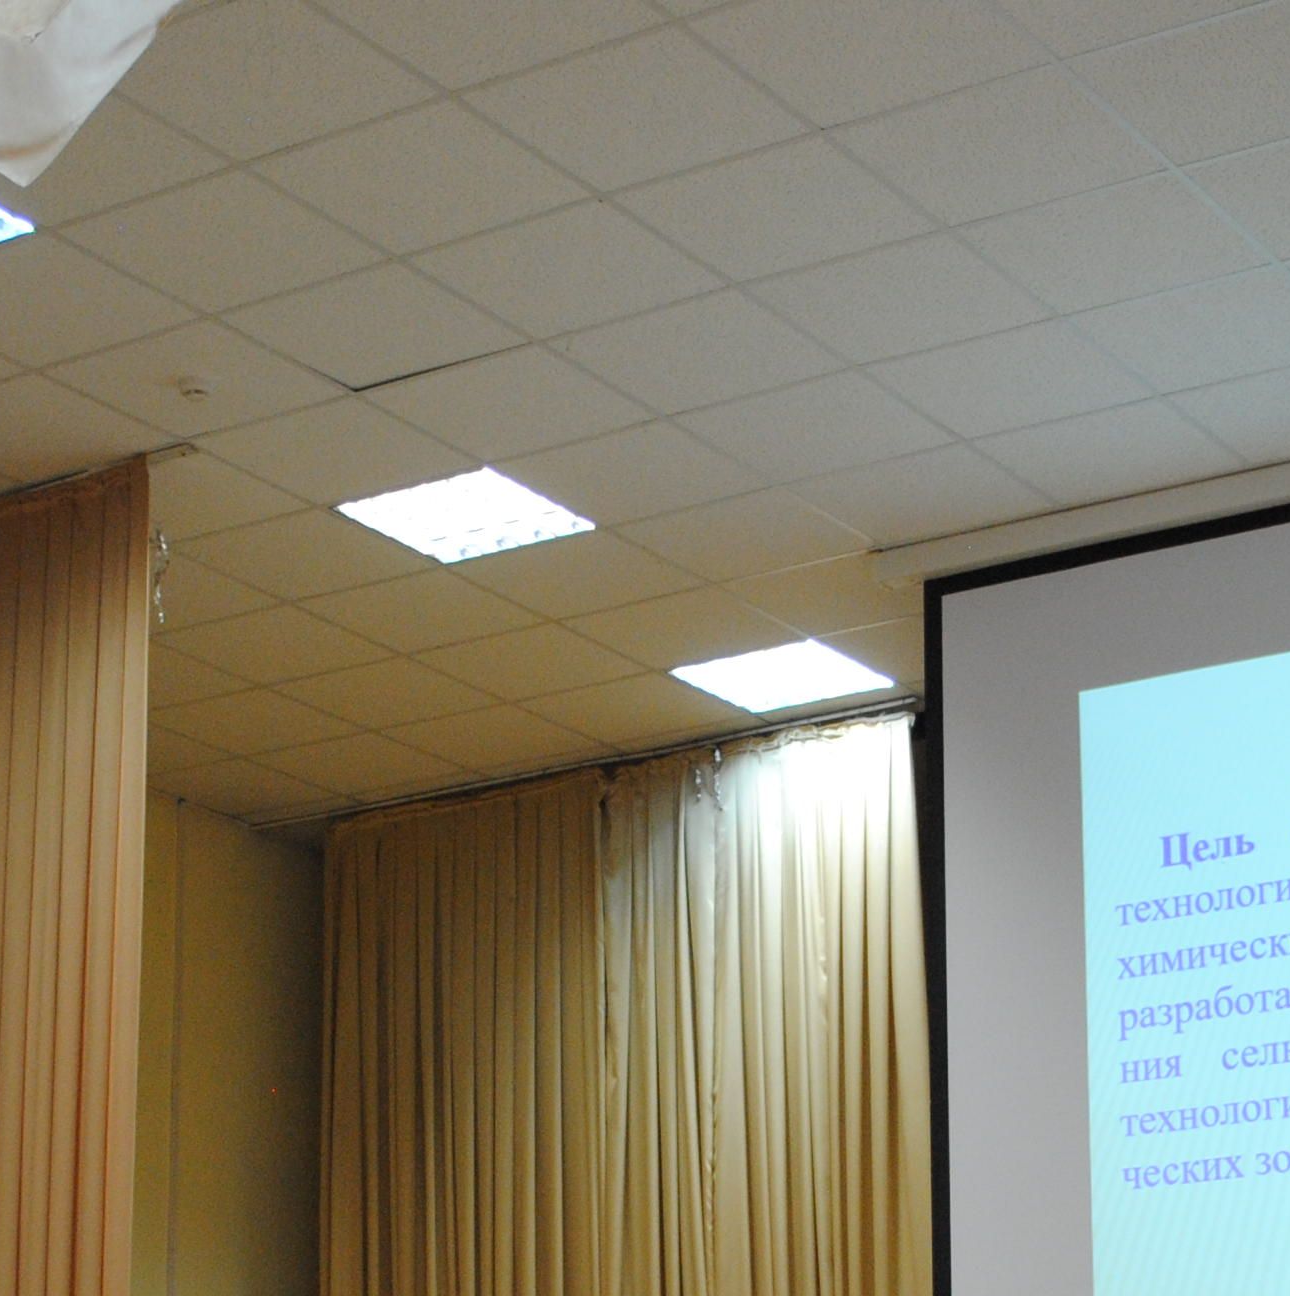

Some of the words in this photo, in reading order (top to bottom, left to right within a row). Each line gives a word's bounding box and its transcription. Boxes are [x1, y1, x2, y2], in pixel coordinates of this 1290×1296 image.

[1161, 832, 1255, 870] Цель
[1121, 1055, 1181, 1083] ния
[1124, 1156, 1244, 1189] ческих
